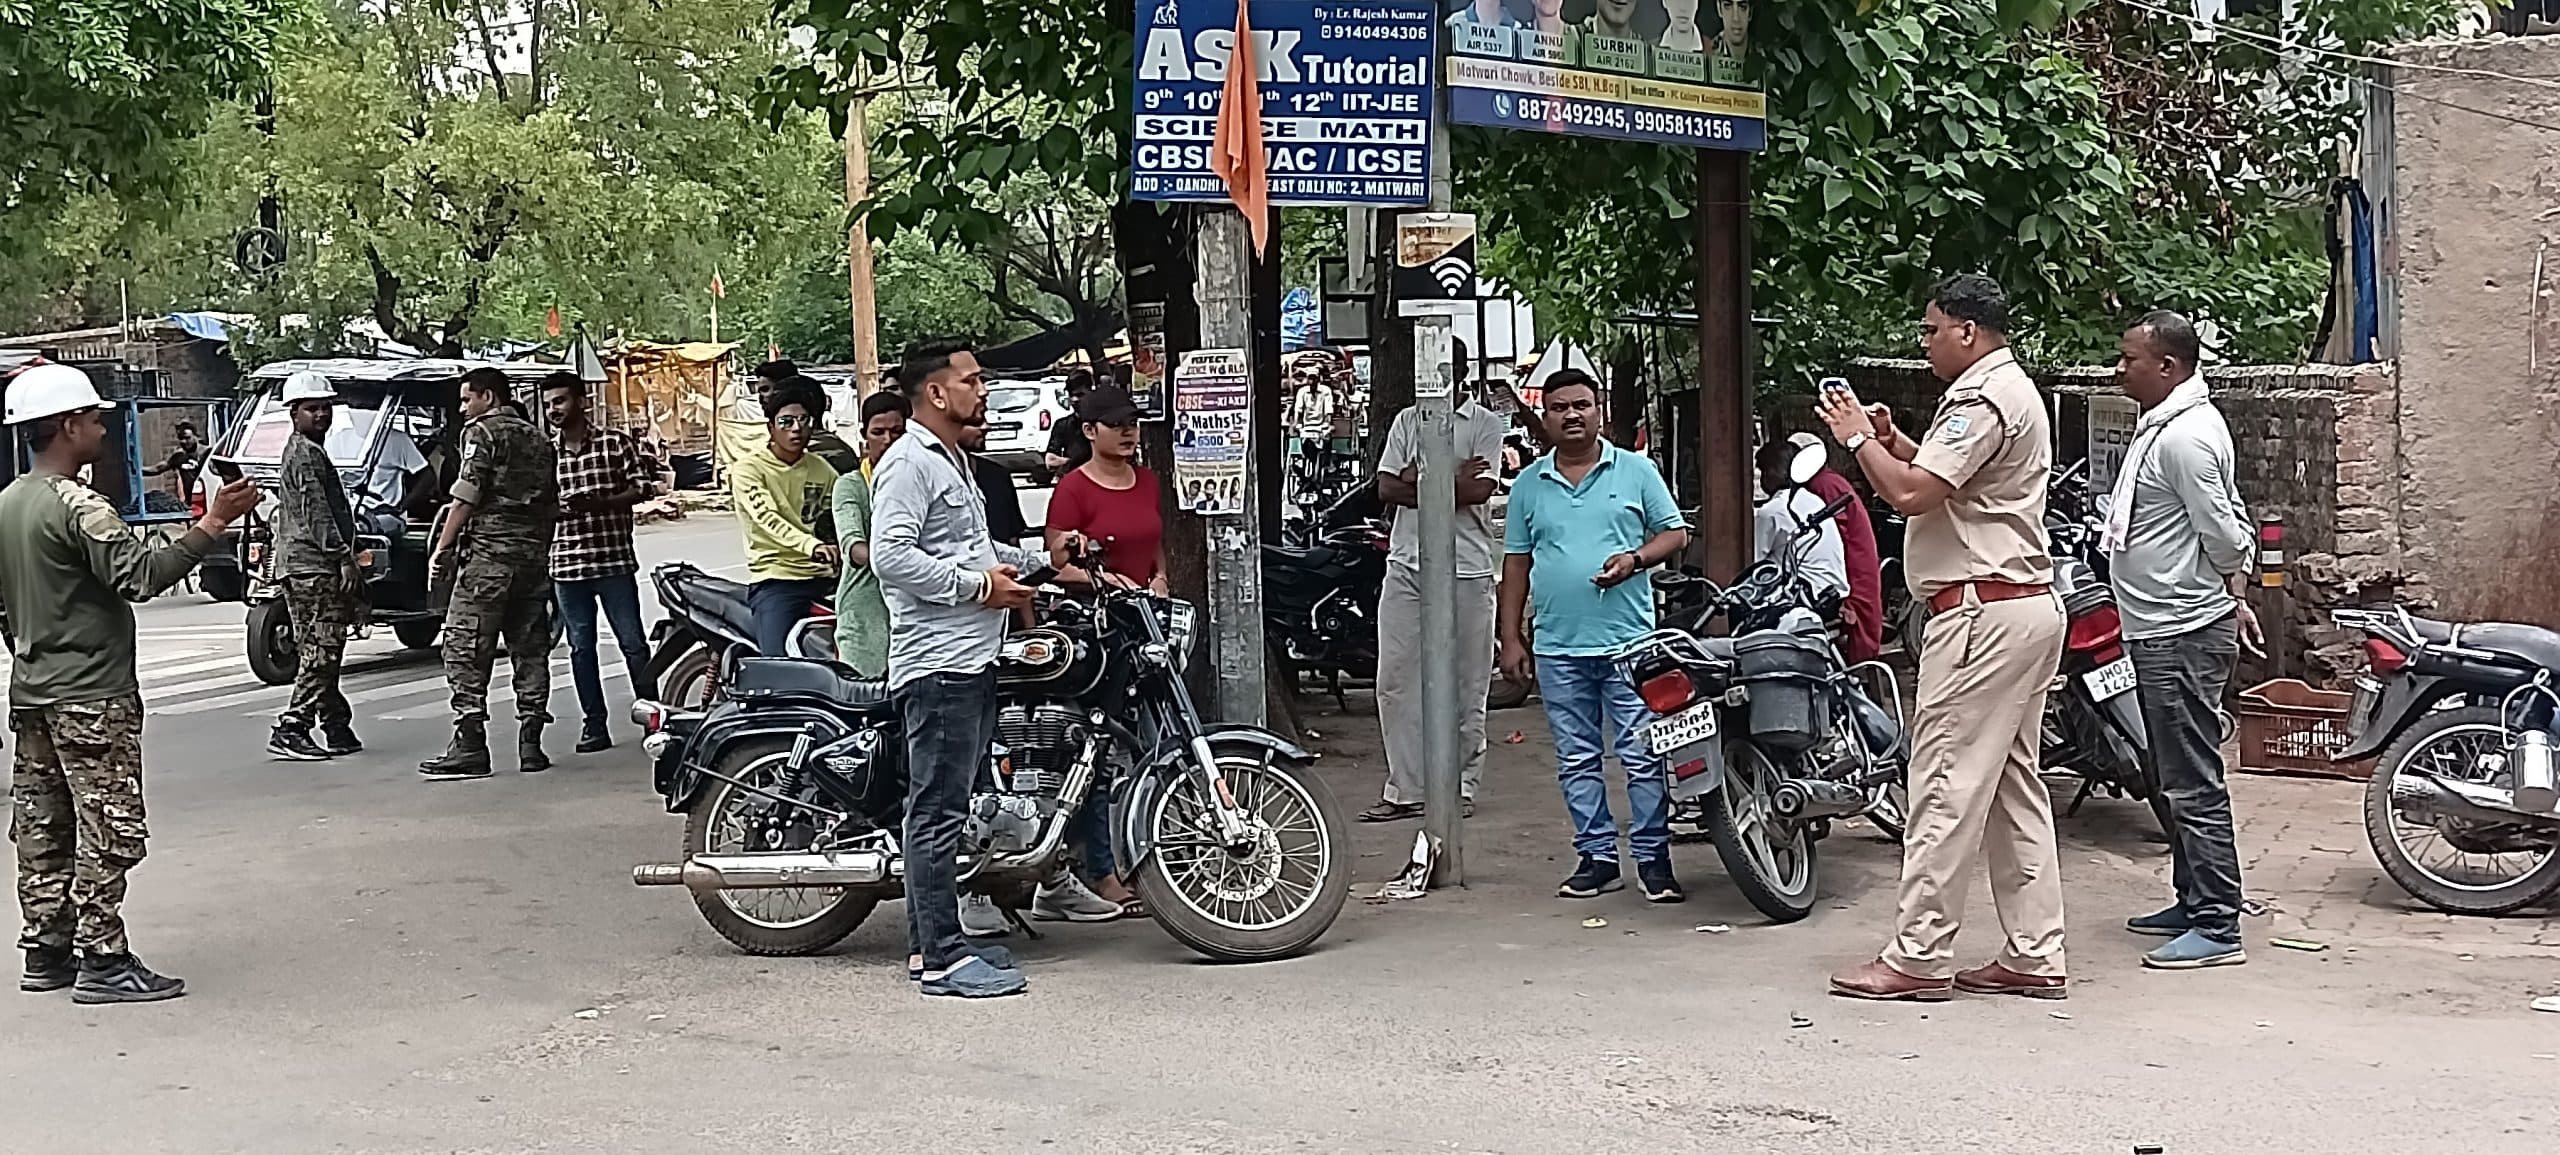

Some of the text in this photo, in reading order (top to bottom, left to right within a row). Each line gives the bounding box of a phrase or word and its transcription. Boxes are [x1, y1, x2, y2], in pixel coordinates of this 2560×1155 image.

[1353, 8, 1388, 21] Rajesh
[1391, 9, 1428, 20] Kumar
[1334, 25, 1427, 39] 9140494306
[1471, 26, 1496, 39] RIYA
[1466, 40, 1481, 50] AIR
[1533, 34, 1563, 47] ANNU
[1592, 37, 1637, 54] SURBHI
[1139, 28, 1426, 85] ASK Tutorial
[1532, 48, 1546, 58] AIR
[1596, 55, 1611, 66] AIR
[1658, 51, 1702, 66] ANAMIKA
[1718, 59, 1744, 70] SACH
[1457, 62, 1498, 80] Matwari
[1539, 71, 1570, 88] Beside
[1145, 88, 1174, 109] 9th
[1290, 91, 1334, 112] 12th
[1342, 93, 1419, 112] IIT-JEE
[1143, 119, 1419, 139] SCIECE MATH
[1634, 111, 1732, 139] 9905813156
[1346, 148, 1423, 173] ICSE
[1134, 177, 1159, 192] ADD
[1365, 182, 1424, 197] MATWARI
[1177, 395, 1204, 410] CBSE
[1191, 414, 1231, 430] Maths
[2099, 660, 2131, 683] JH02
